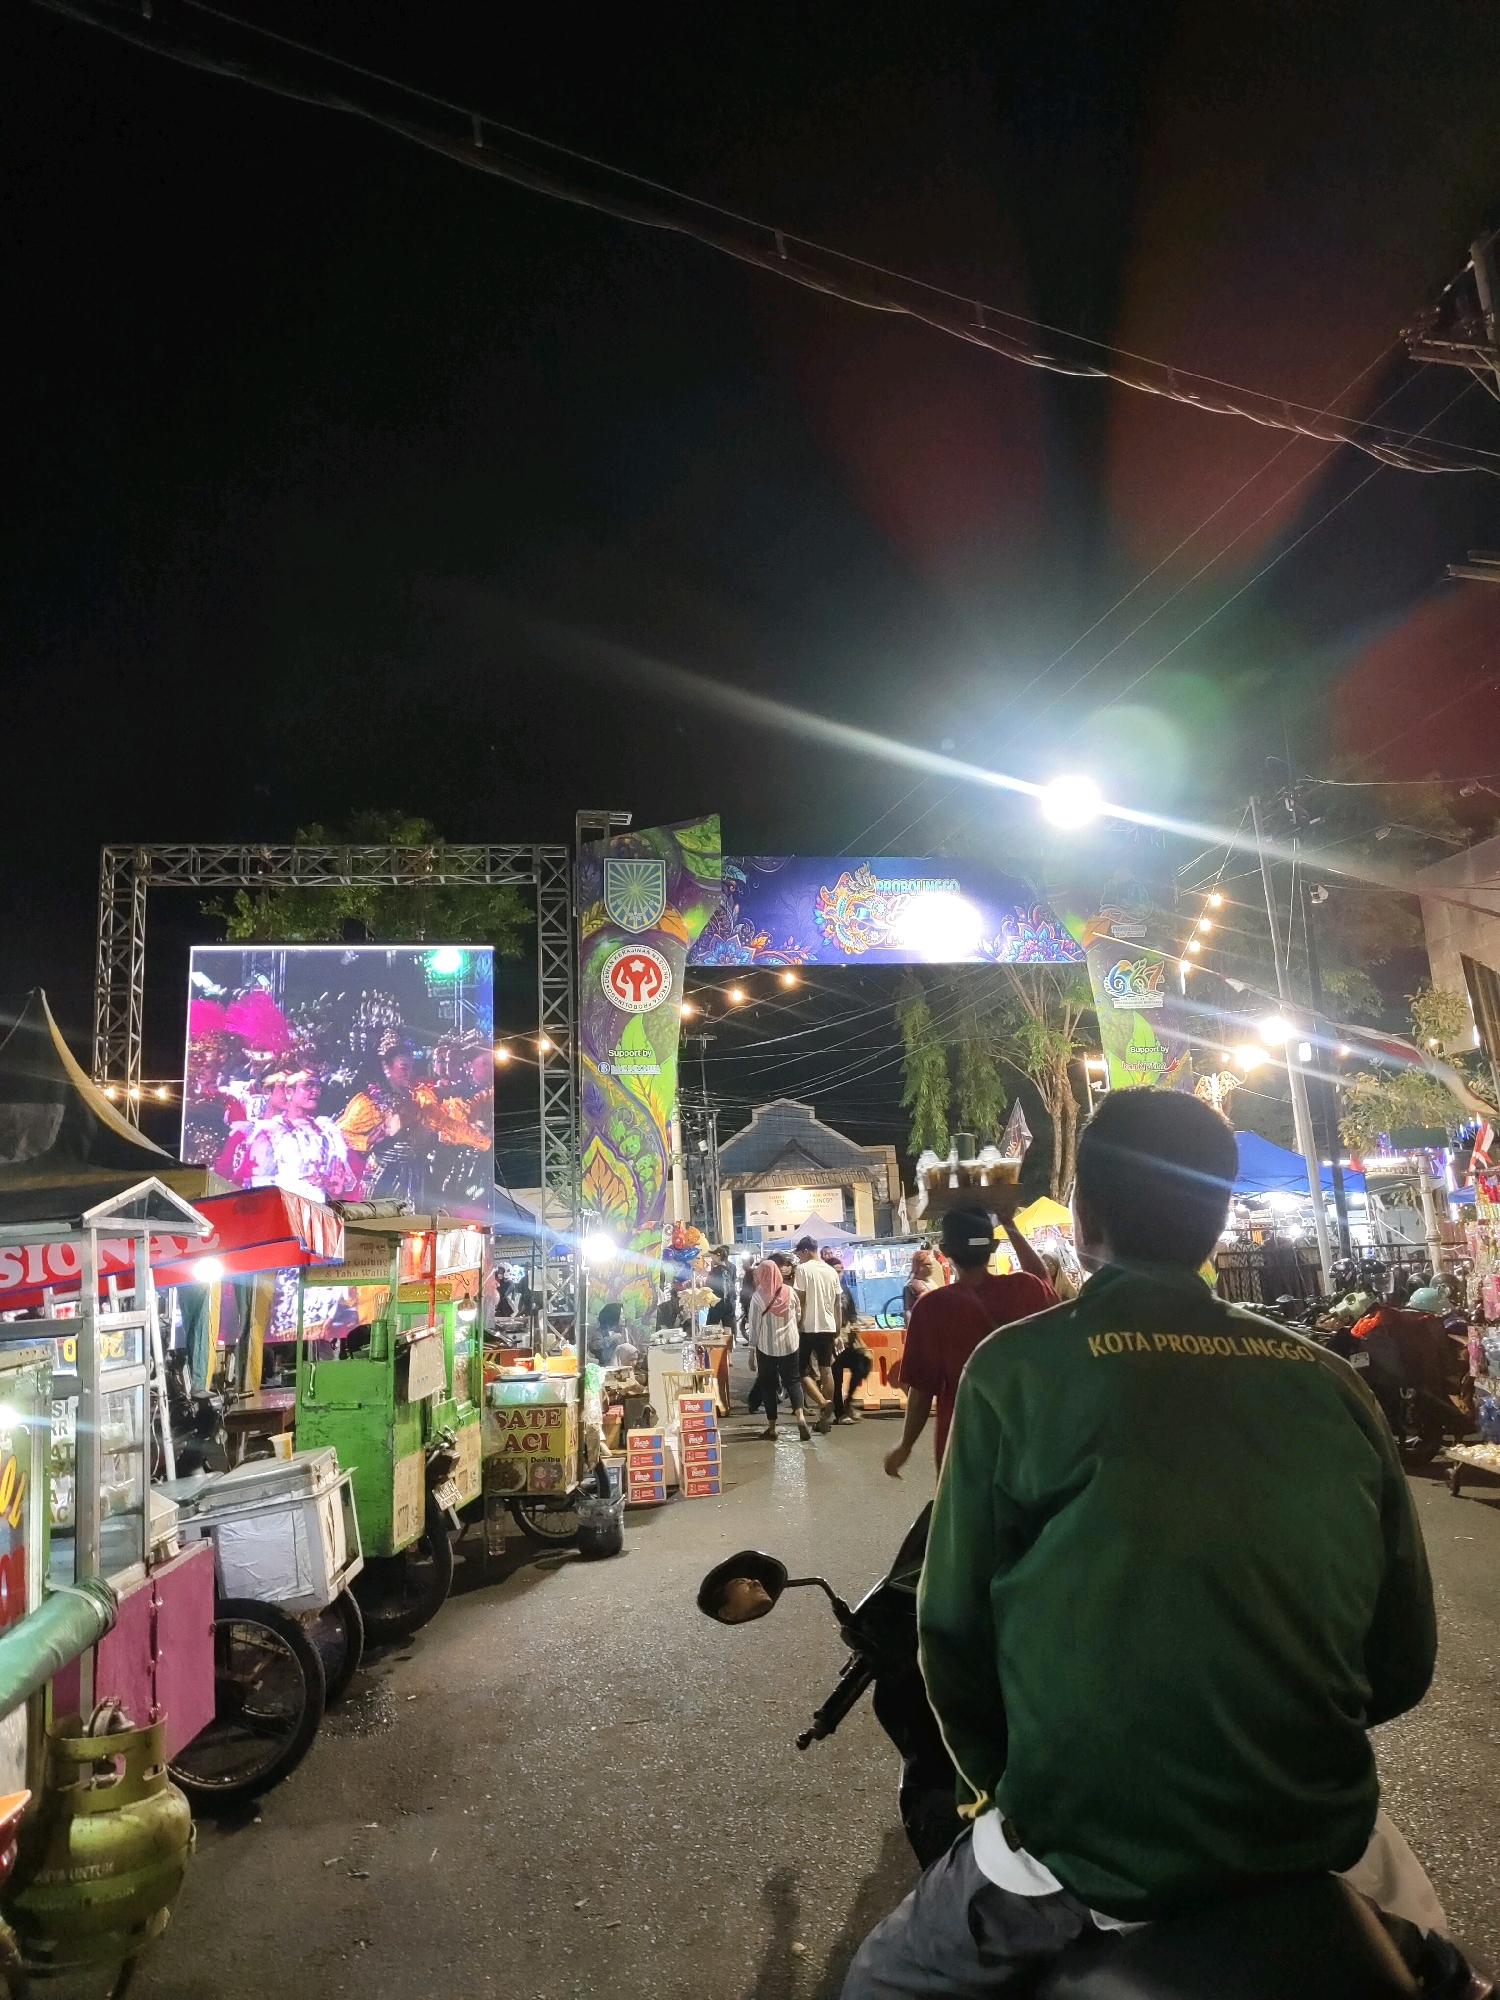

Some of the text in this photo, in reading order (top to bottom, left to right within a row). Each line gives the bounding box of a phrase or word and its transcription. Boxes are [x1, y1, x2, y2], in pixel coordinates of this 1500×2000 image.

[875, 878, 961, 896] PROBOLINGGO
[608, 1049, 652, 1058] Support by
[1130, 1045, 1170, 1054] Support by
[325, 1268, 390, 1278] & Tahu Walik
[1087, 1331, 1151, 1358] KOTA
[1151, 1333, 1317, 1363] PROBOLINGGO
[493, 1408, 562, 1430] SATE
[504, 1431, 551, 1454] ACI
